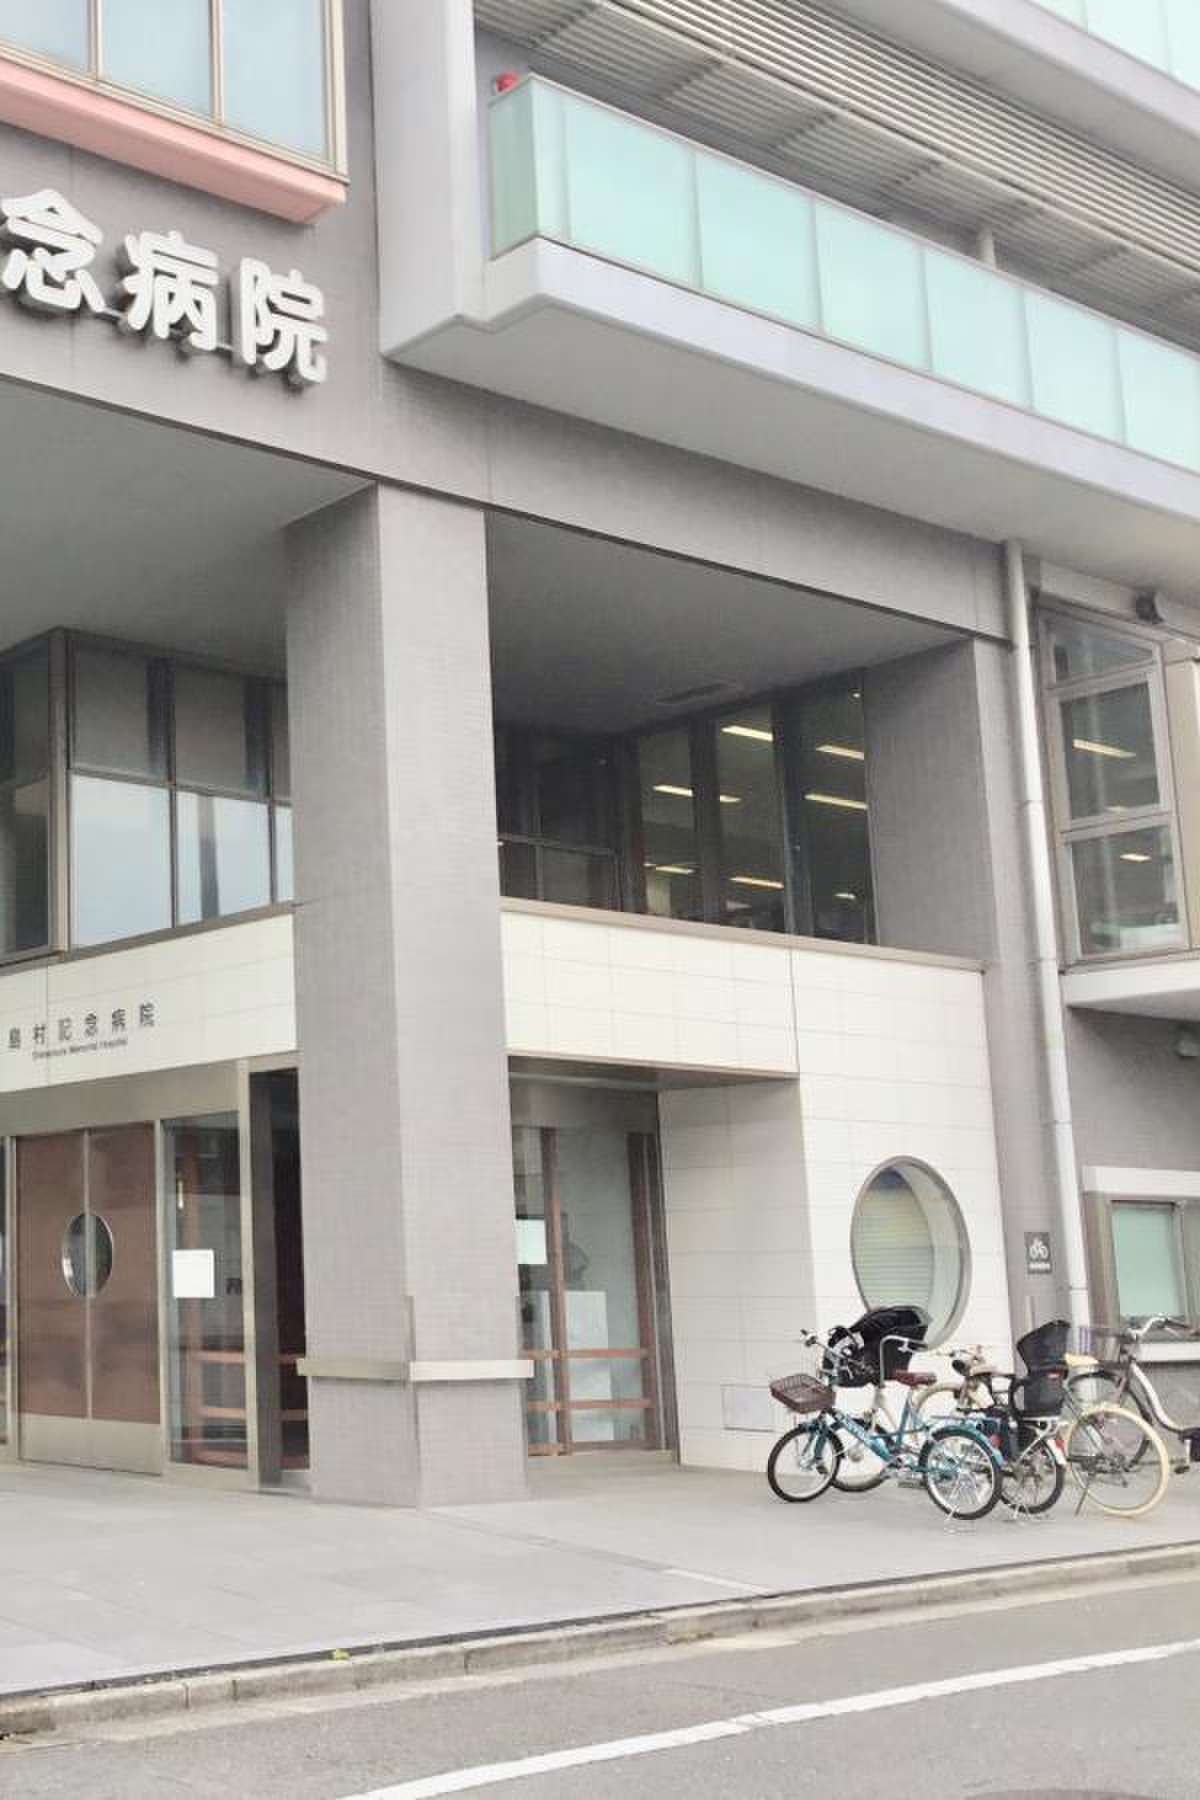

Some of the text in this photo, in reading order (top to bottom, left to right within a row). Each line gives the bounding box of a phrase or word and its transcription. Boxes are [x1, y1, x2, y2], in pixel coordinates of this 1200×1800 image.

[8, 1002, 155, 1049] 島村記念病院
